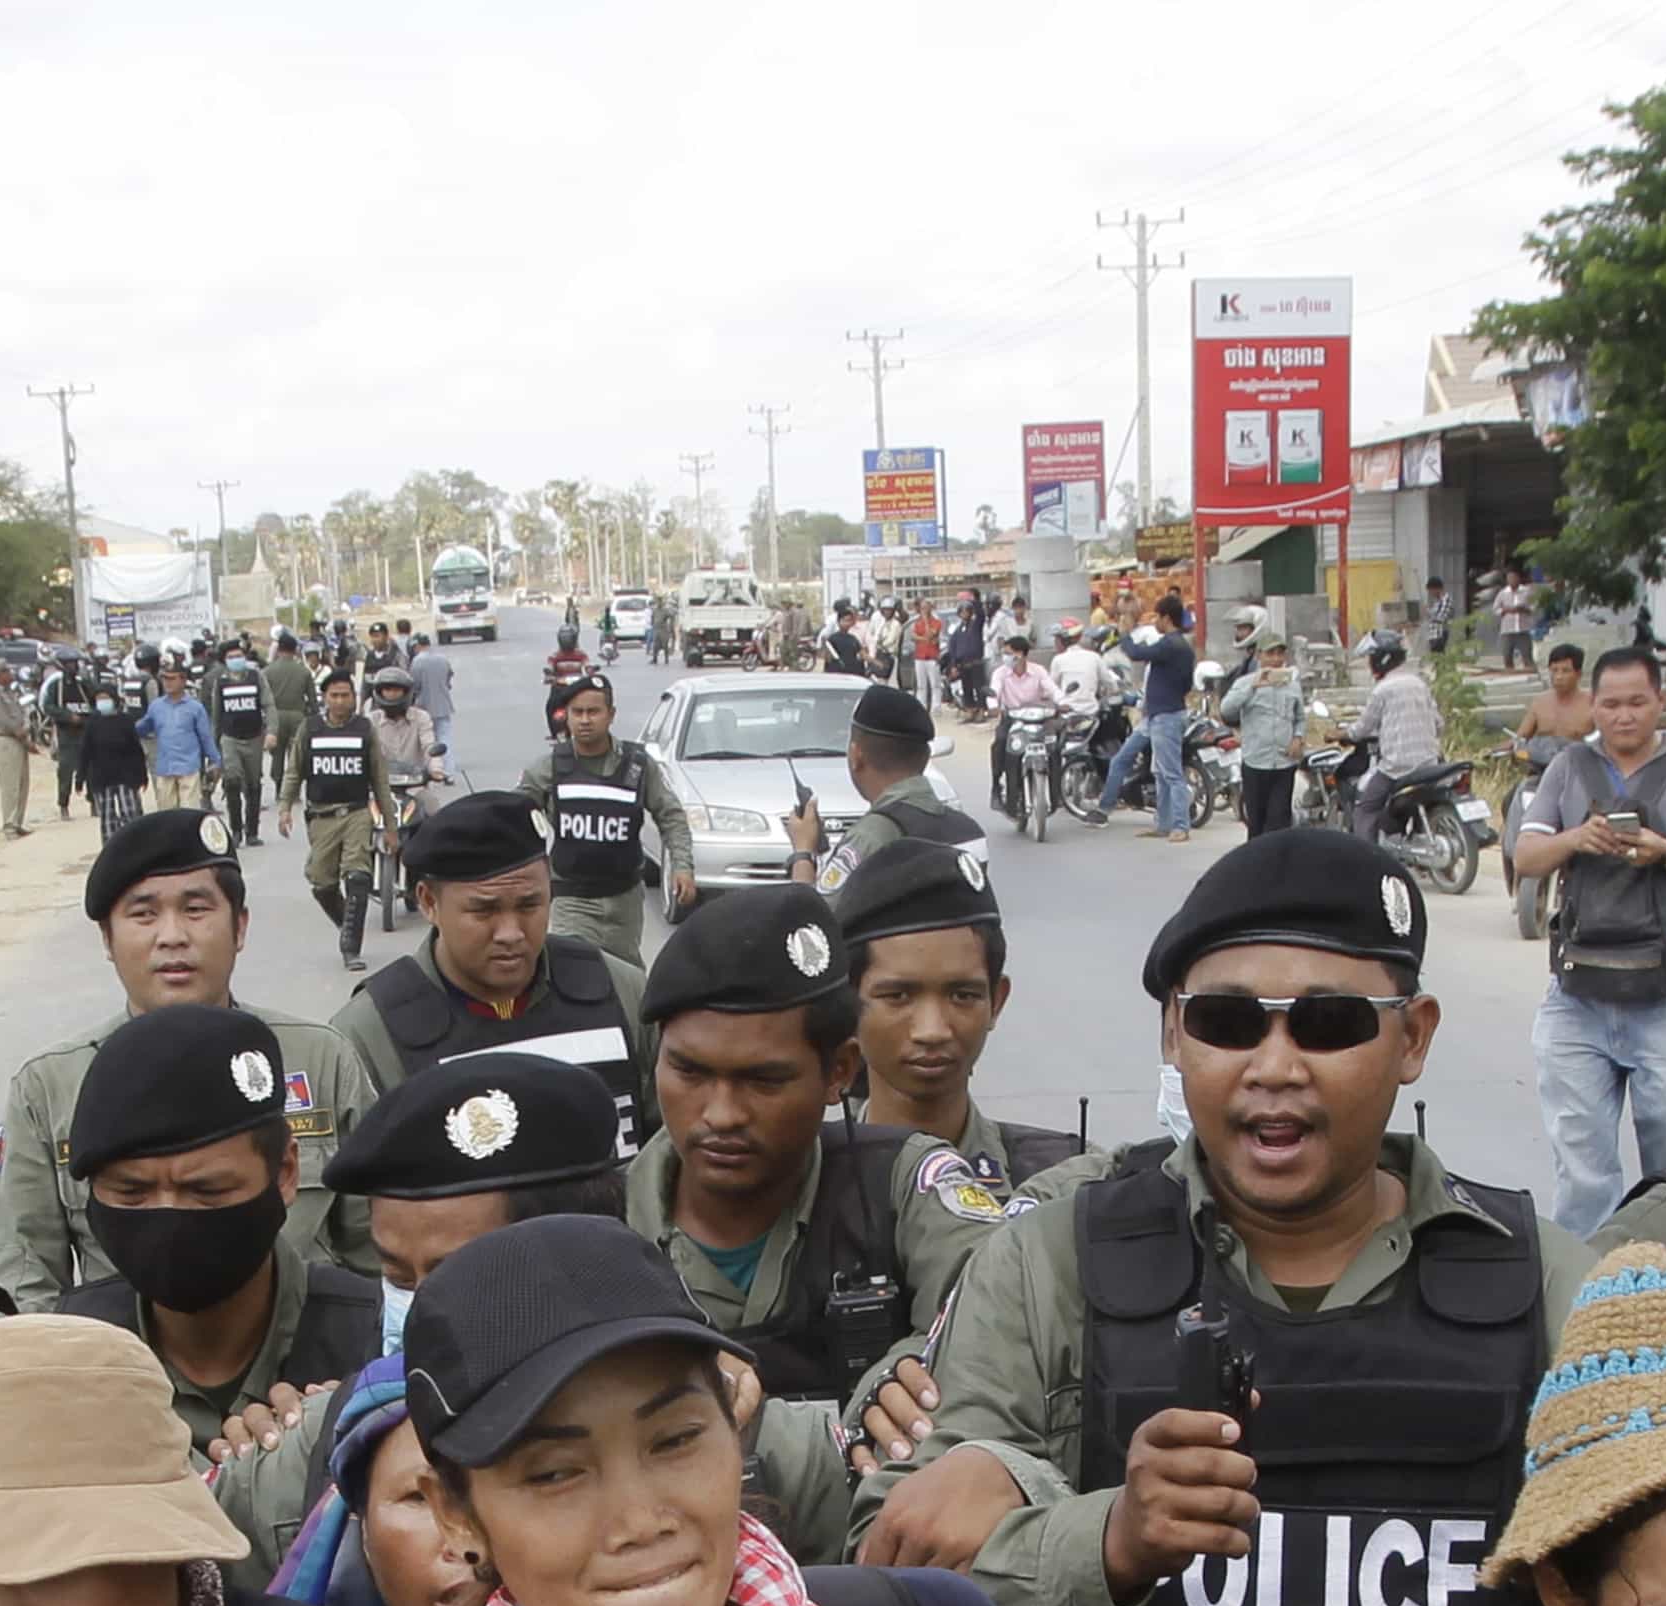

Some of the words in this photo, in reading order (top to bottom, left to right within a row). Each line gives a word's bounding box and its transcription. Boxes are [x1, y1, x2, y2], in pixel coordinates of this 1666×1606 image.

[224, 697, 257, 713] POLICE
[312, 756, 363, 775] POLICE
[560, 813, 630, 842] POLICE
